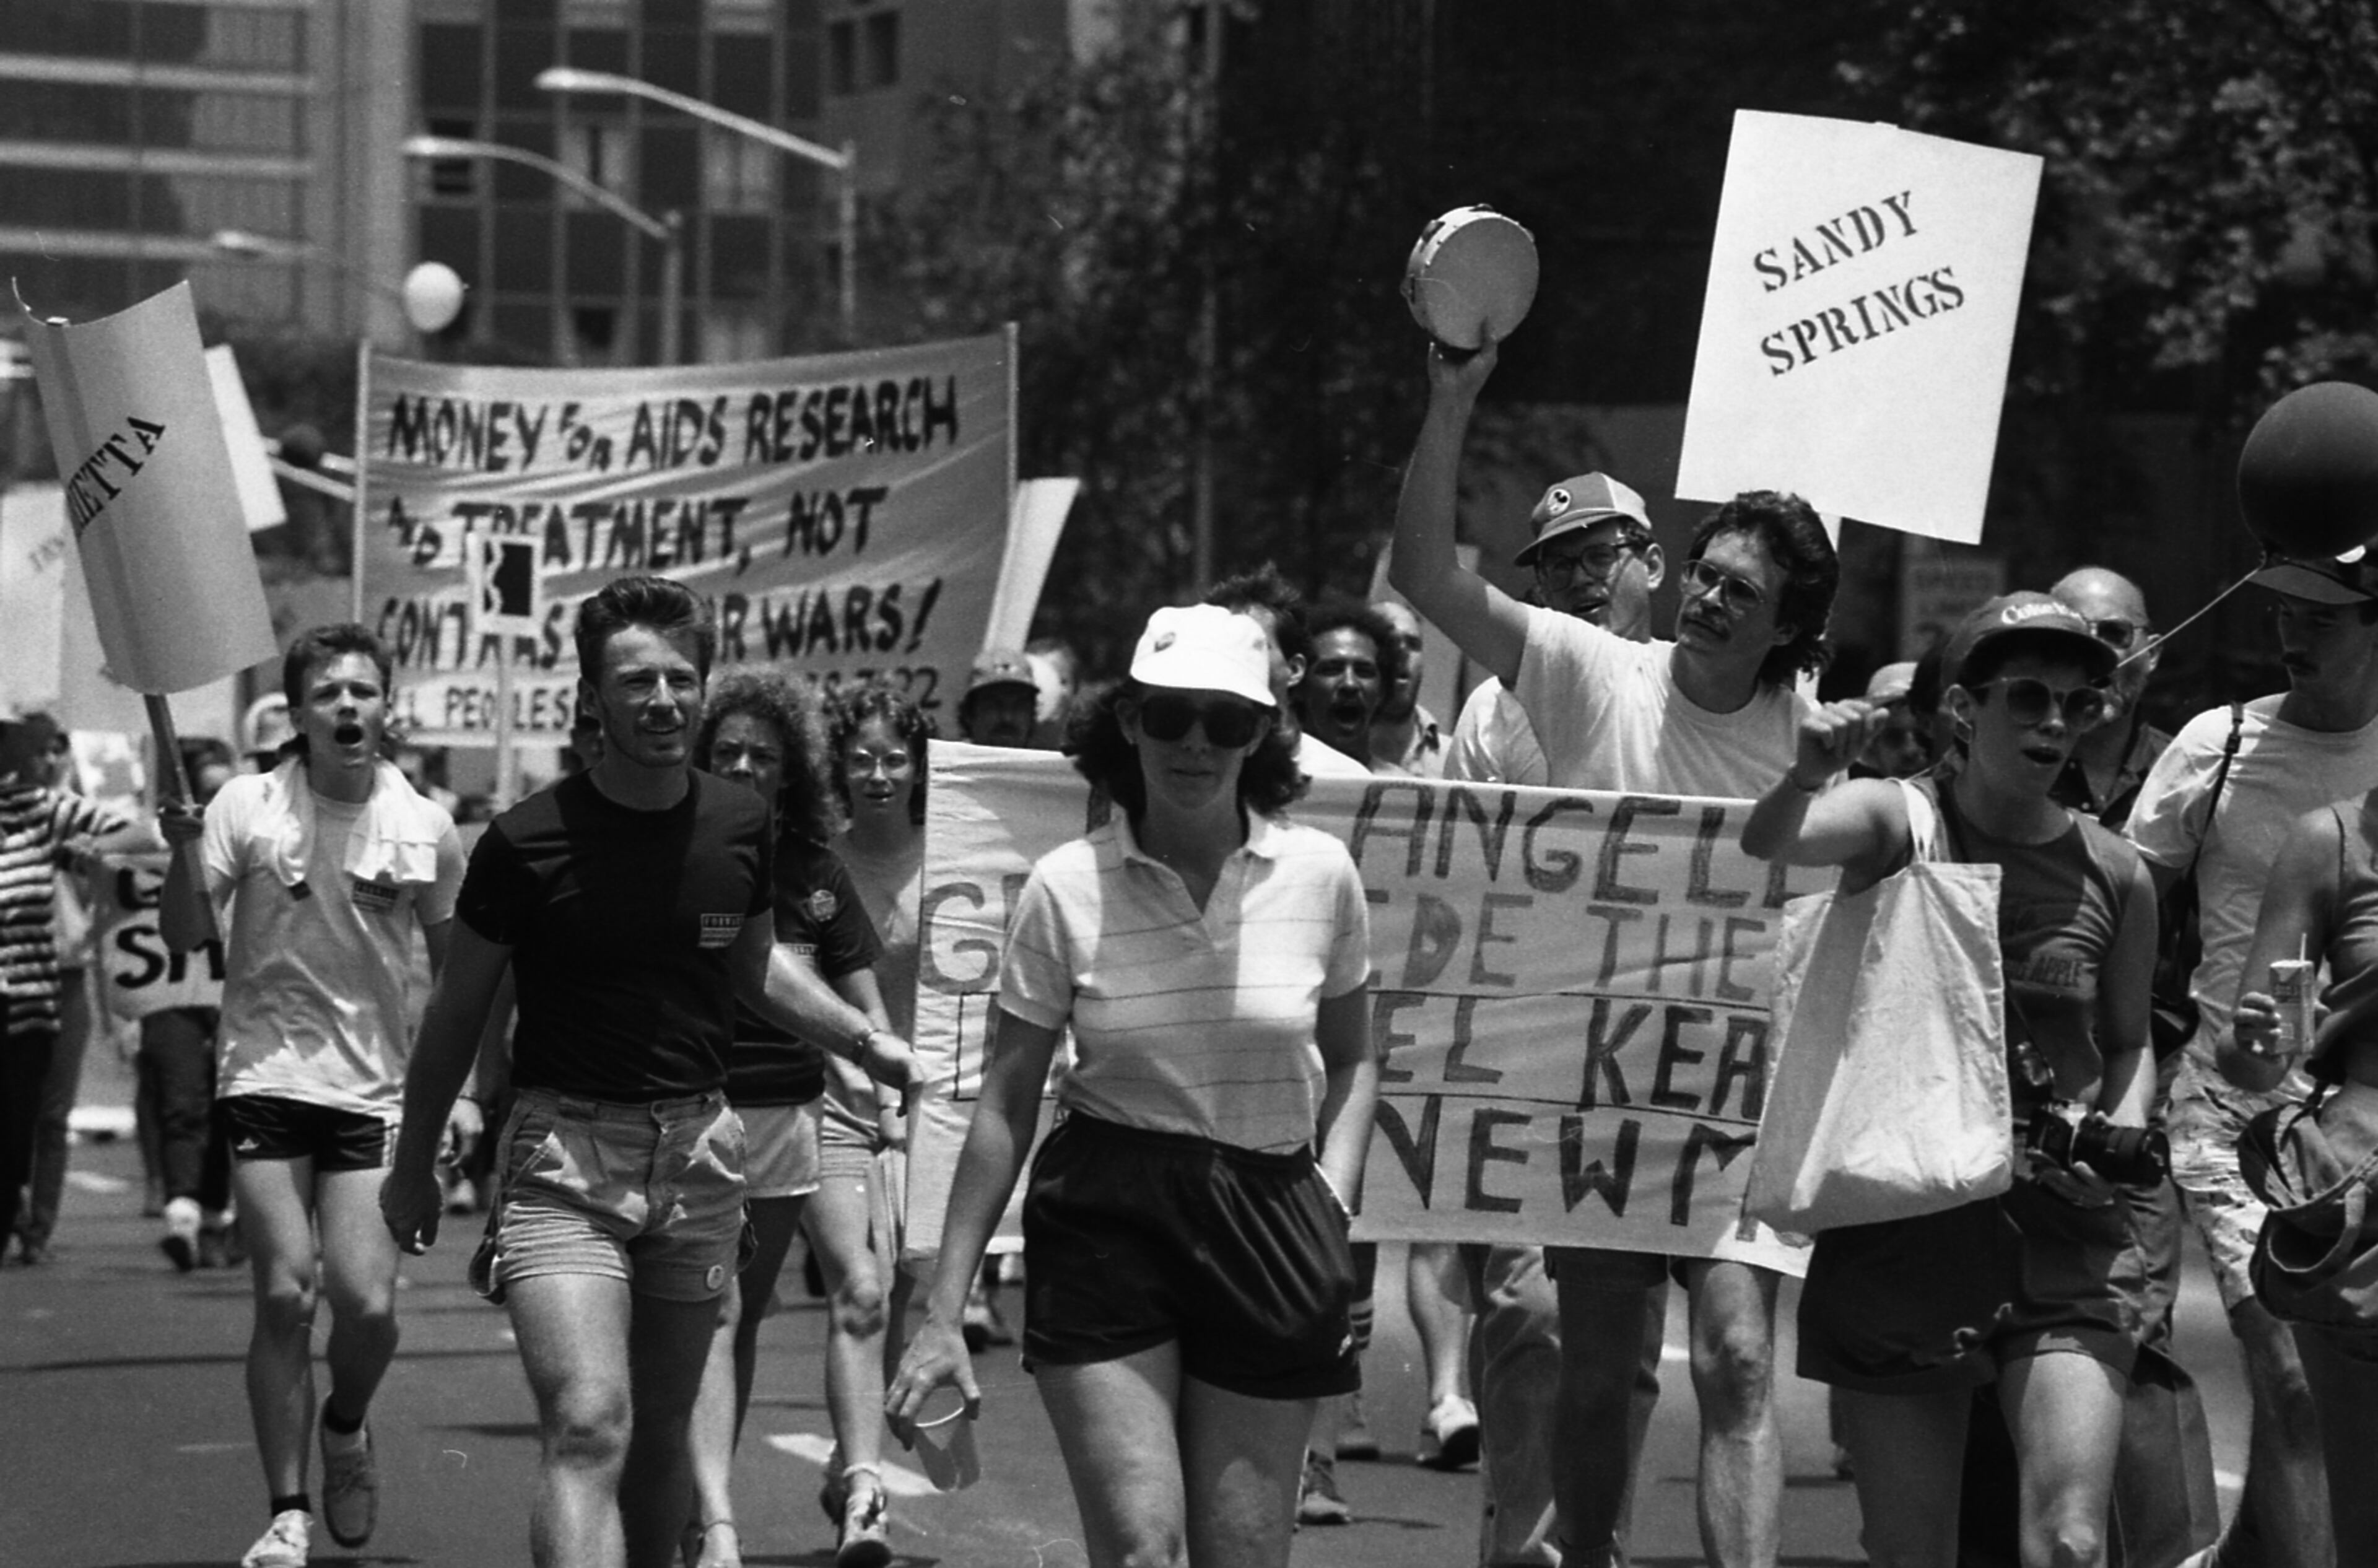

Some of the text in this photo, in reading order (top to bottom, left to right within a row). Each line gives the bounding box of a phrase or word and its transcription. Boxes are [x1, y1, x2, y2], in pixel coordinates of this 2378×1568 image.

[1753, 190, 1917, 292] SANDY
[1761, 266, 1964, 377] SPRINGS
[389, 393, 547, 472] MONEY
[625, 396, 728, 471] AIDS
[747, 374, 958, 464] RESEARCH
[785, 486, 889, 557] NOT
[761, 577, 943, 660] WARS!
[445, 685, 571, 730] PEOLES
[1587, 904, 1767, 1002] THE
